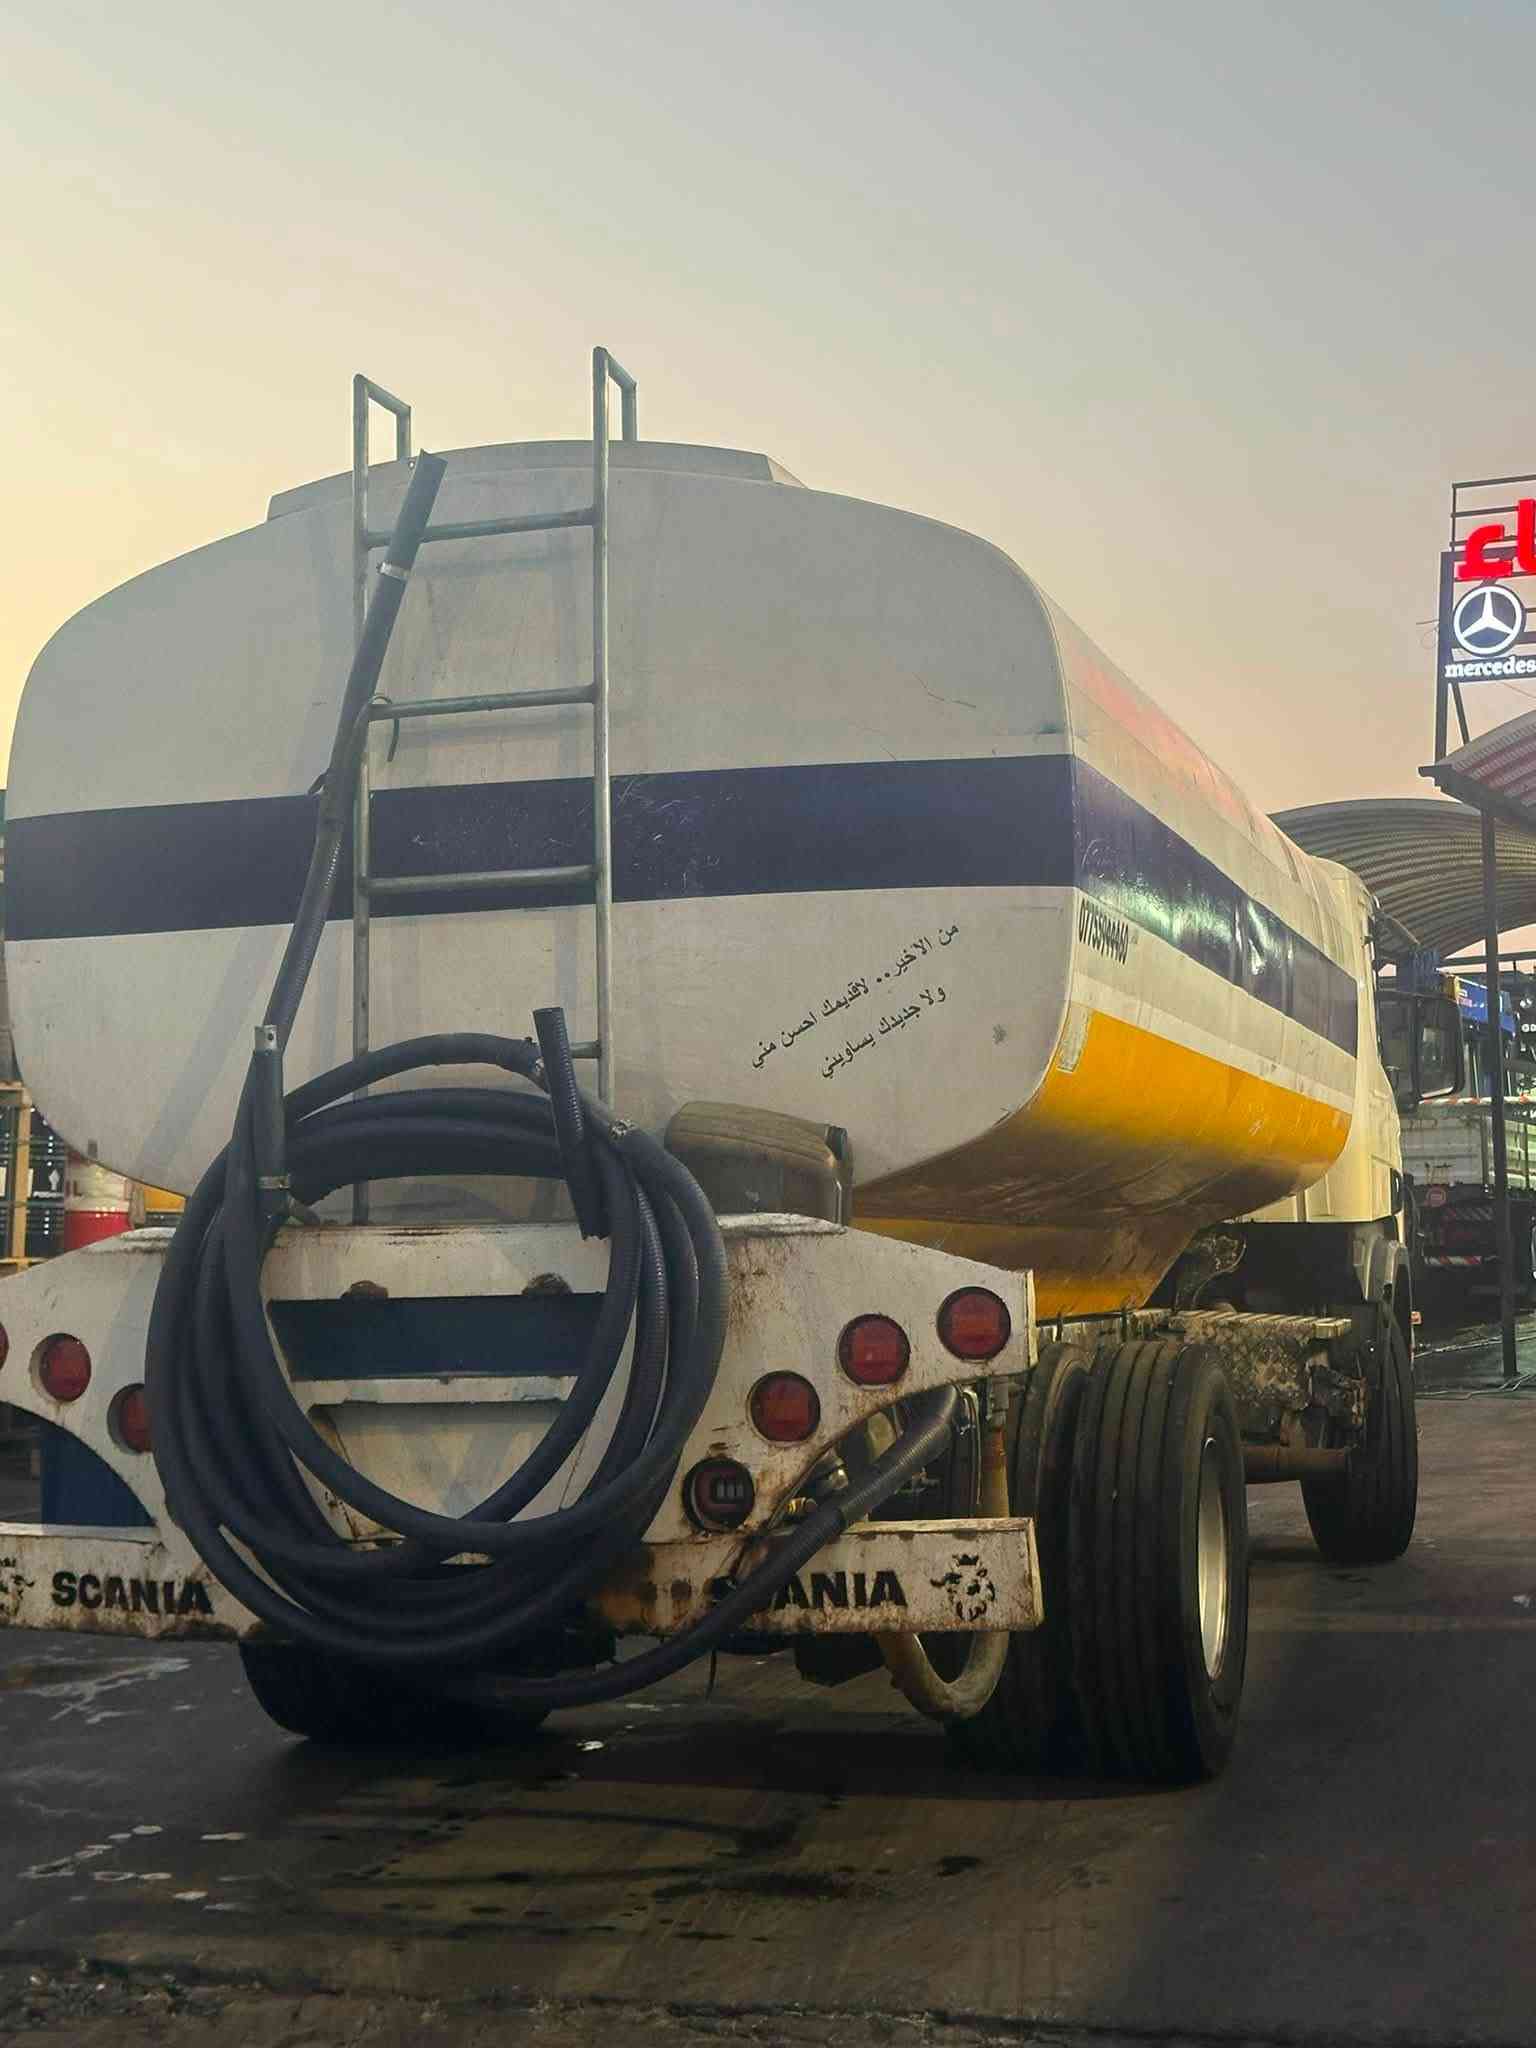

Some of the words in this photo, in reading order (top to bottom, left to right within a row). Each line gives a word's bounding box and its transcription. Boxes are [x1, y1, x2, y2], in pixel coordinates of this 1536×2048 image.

[938, 925, 959, 946] من
[780, 1011, 818, 1048] احسن
[879, 1005, 921, 1035] جديدك
[752, 1041, 777, 1070] مني
[822, 1033, 876, 1080] يساويني
[51, 1570, 213, 1615] SCANIA
[772, 1569, 908, 1610] ANIA
